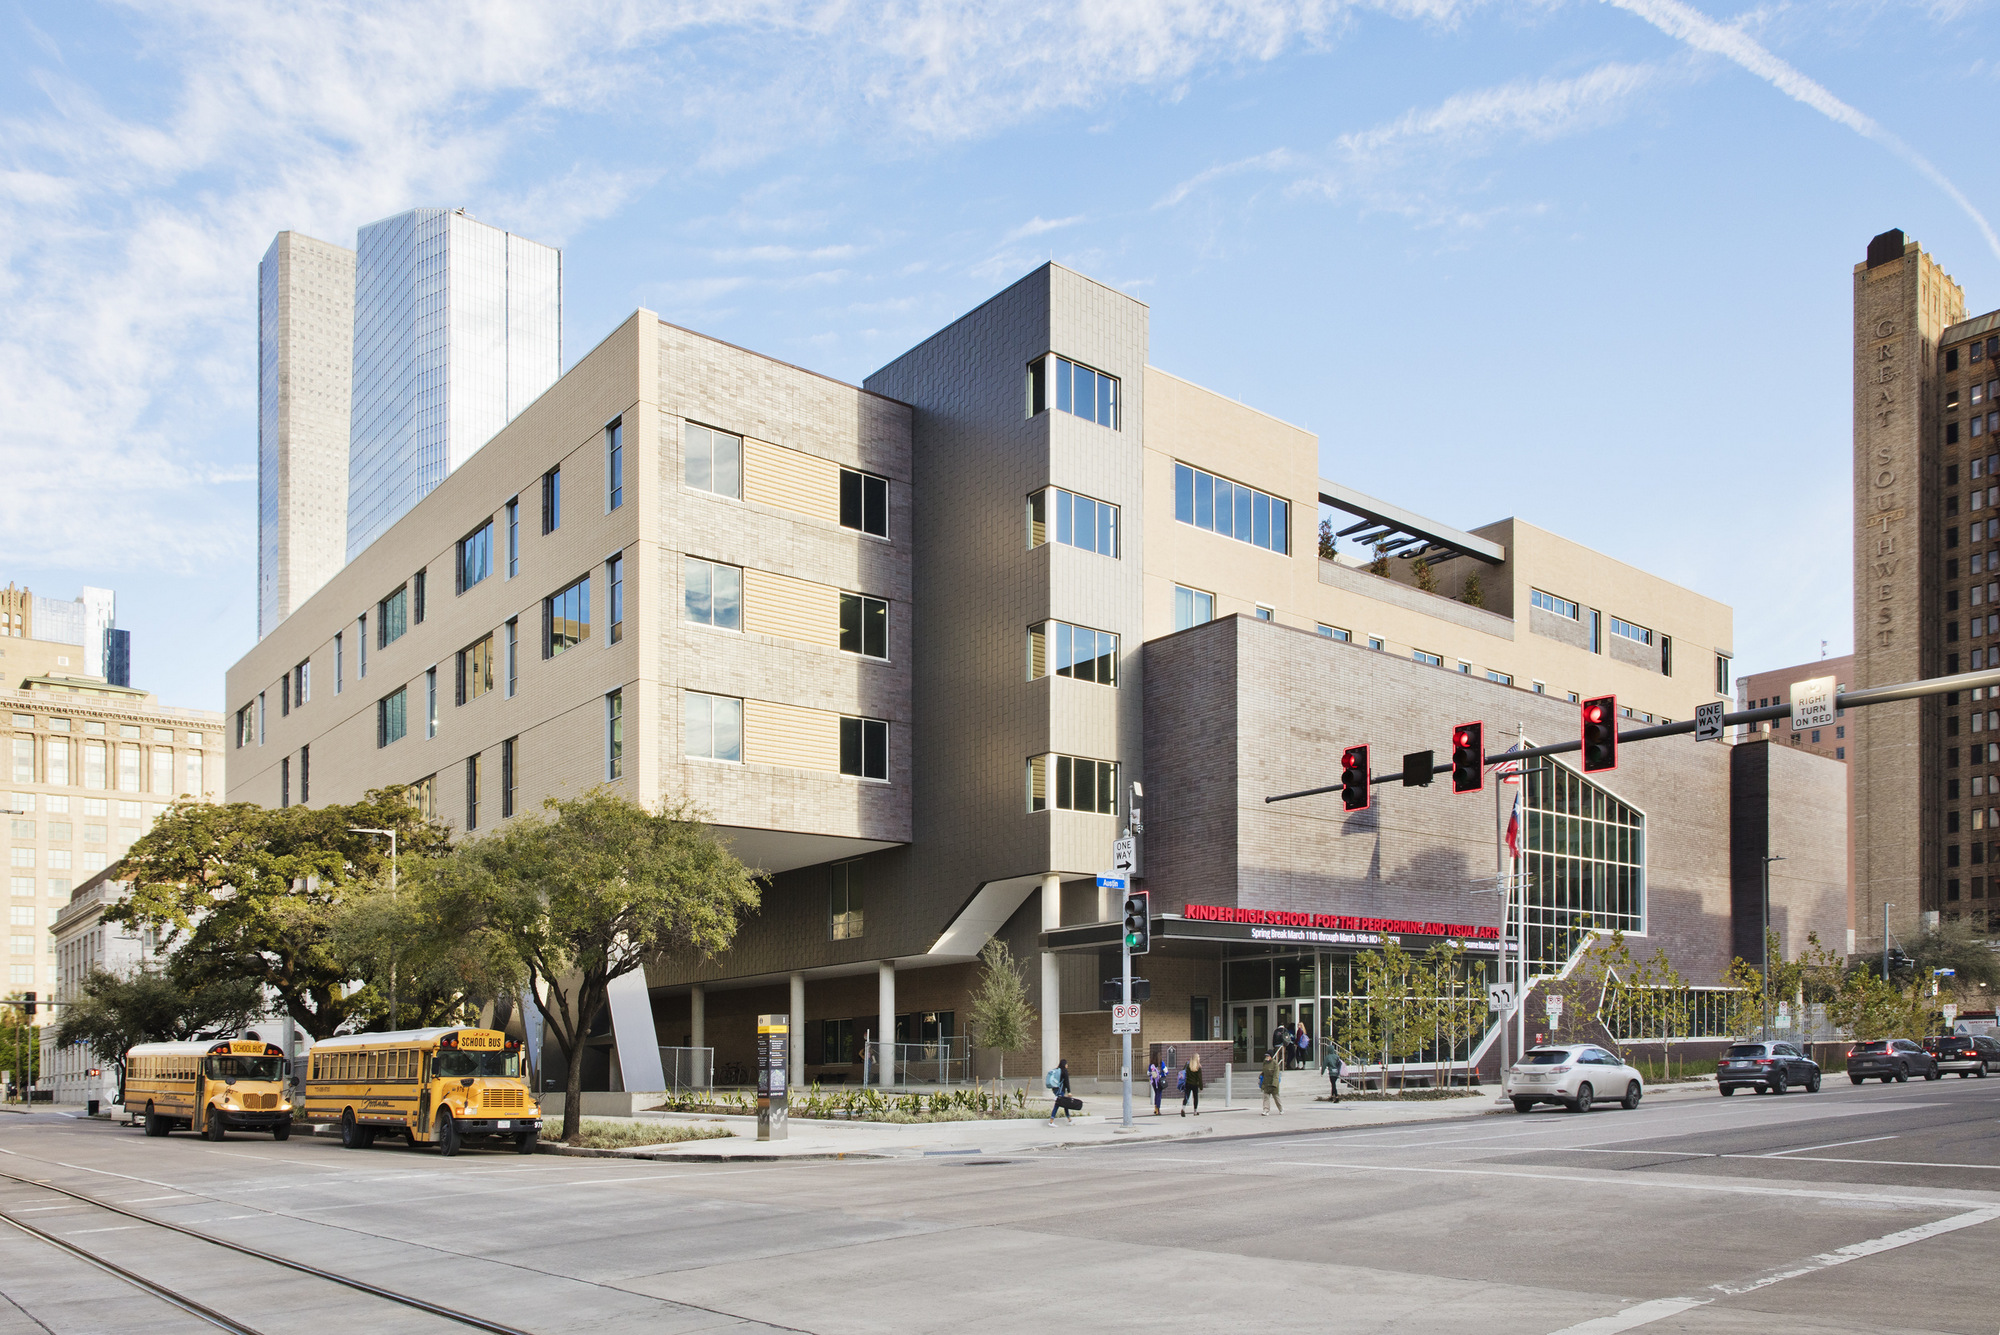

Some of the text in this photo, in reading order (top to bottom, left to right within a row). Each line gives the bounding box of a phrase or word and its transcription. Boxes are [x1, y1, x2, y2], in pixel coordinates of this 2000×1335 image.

[1870, 320, 1900, 648] GREAT SOUTHWEST
[1798, 694, 1827, 706] RIGHT
[1699, 704, 1721, 717] ONE
[1800, 705, 1826, 716] TURN
[1698, 715, 1721, 727] WAY
[1795, 714, 1832, 727] ON RED
[1116, 840, 1132, 851] ONE
[1116, 850, 1132, 860] WAY
[1103, 879, 1119, 889] Austin
[1185, 904, 1500, 939] KINDER HIGH SCHOOL FOR THE PERFORMING AND VISUAL ARTS
[1251, 928, 1271, 939] Spring
[1271, 929, 1287, 939] Break
[1287, 930, 1305, 940] March
[1305, 931, 1318, 940] 11th
[1318, 932, 1339, 943] through
[1339, 932, 1356, 942] March
[1369, 935, 1378, 944] NO
[1479, 941, 1495, 951] Monday
[461, 1036, 501, 1047] SCHOOL BUS
[232, 1044, 263, 1053] SCHOOL BUS
